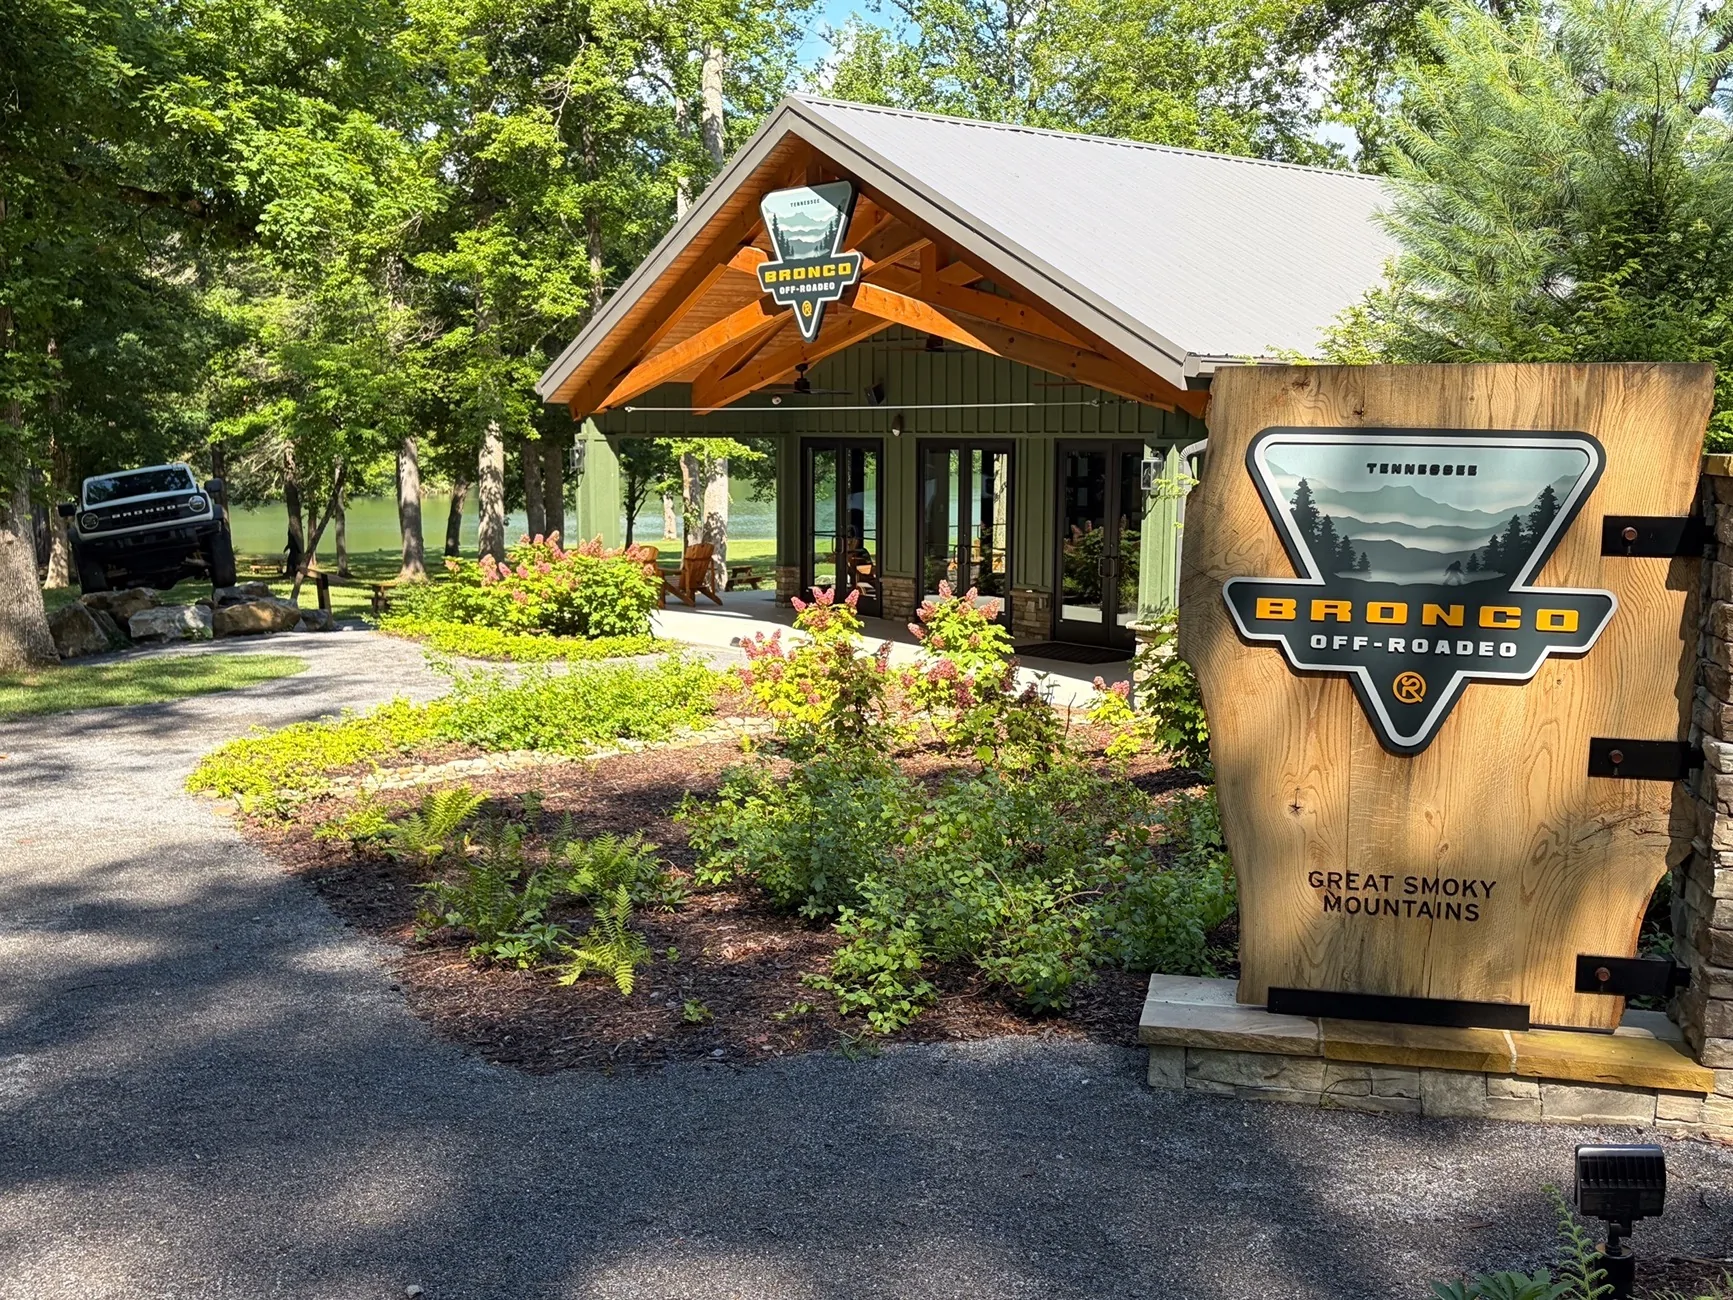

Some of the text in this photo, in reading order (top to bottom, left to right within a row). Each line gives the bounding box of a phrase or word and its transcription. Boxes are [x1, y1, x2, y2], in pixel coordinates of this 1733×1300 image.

[790, 198, 820, 208] TENNESSEE
[764, 262, 852, 283] BRONCO
[779, 281, 836, 295] OFF-ROADEO
[1366, 462, 1478, 476] TENNESSEE
[111, 504, 176, 519] BRONCO
[1255, 597, 1580, 633] BRONCO
[1309, 634, 1518, 658] OFF-ROADEO
[1308, 870, 1497, 899] GREAT SMOKY
[1323, 894, 1480, 922] MOUNTAINS
